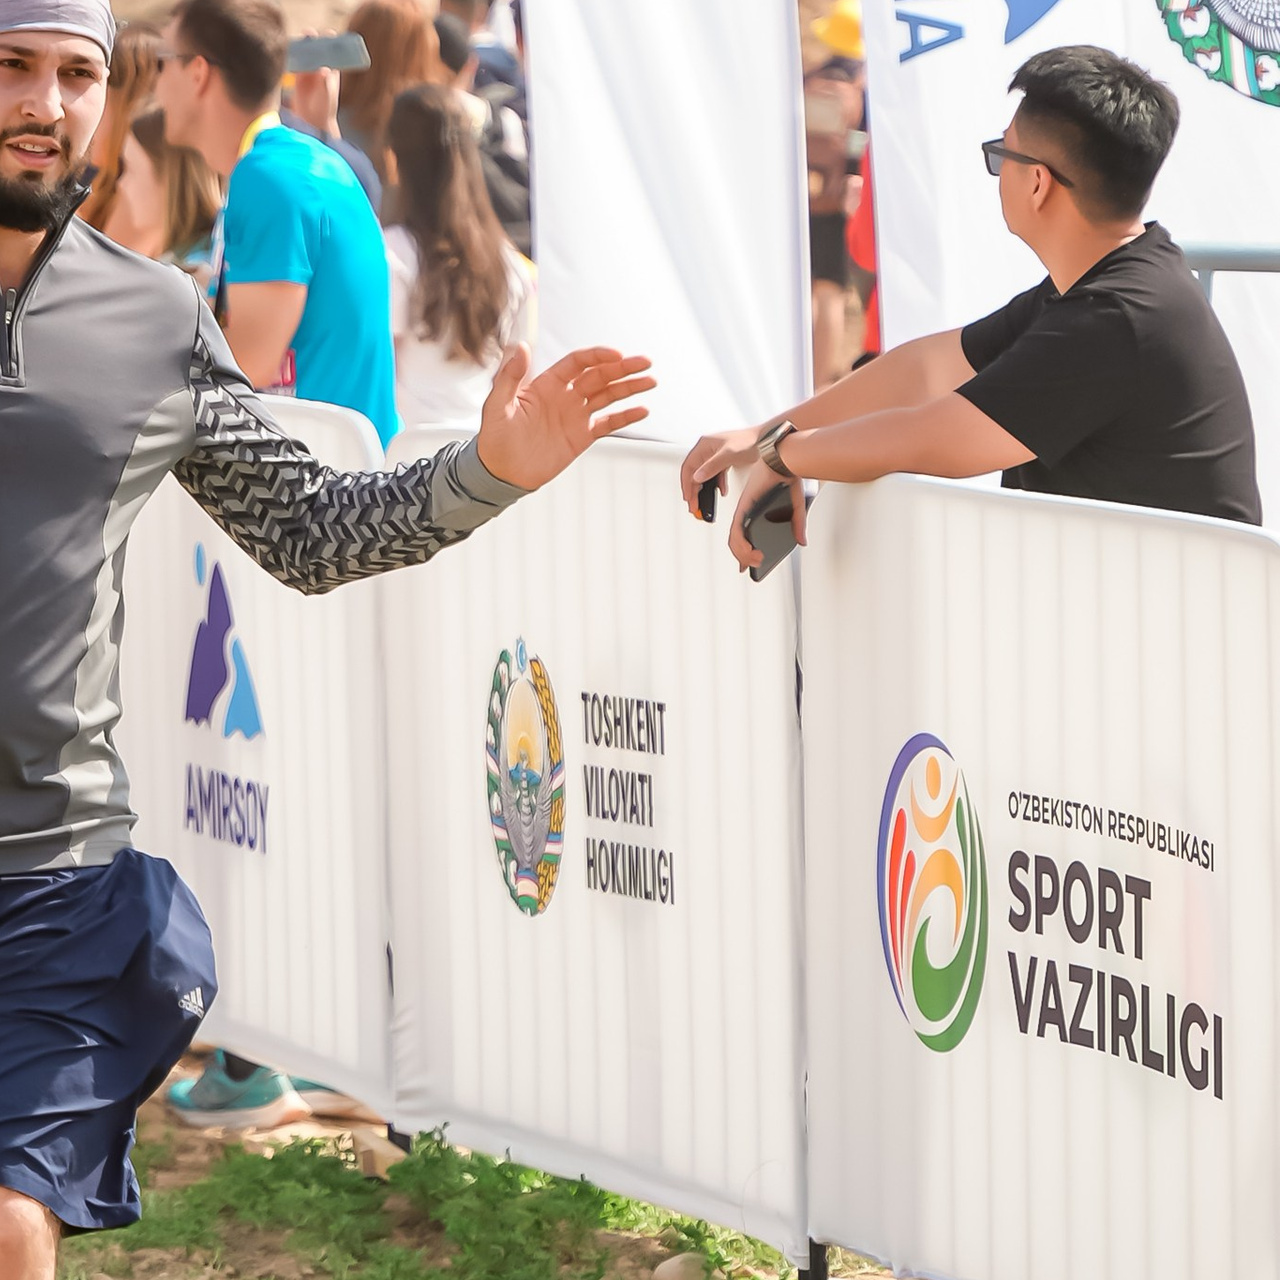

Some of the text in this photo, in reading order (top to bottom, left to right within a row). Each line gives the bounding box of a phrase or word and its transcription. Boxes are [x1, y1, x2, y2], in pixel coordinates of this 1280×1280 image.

[581, 690, 667, 756] TOSHKENT
[183, 762, 270, 856] AMIRSOY
[583, 764, 654, 828] VILOYATI
[1007, 790, 1215, 872] O'ZBEKISTON RESPUBLIKASI
[586, 837, 676, 906] HOKIMLIGI
[1007, 849, 1152, 961] SPORT
[1007, 950, 1224, 1102] VAZIRLIGI
